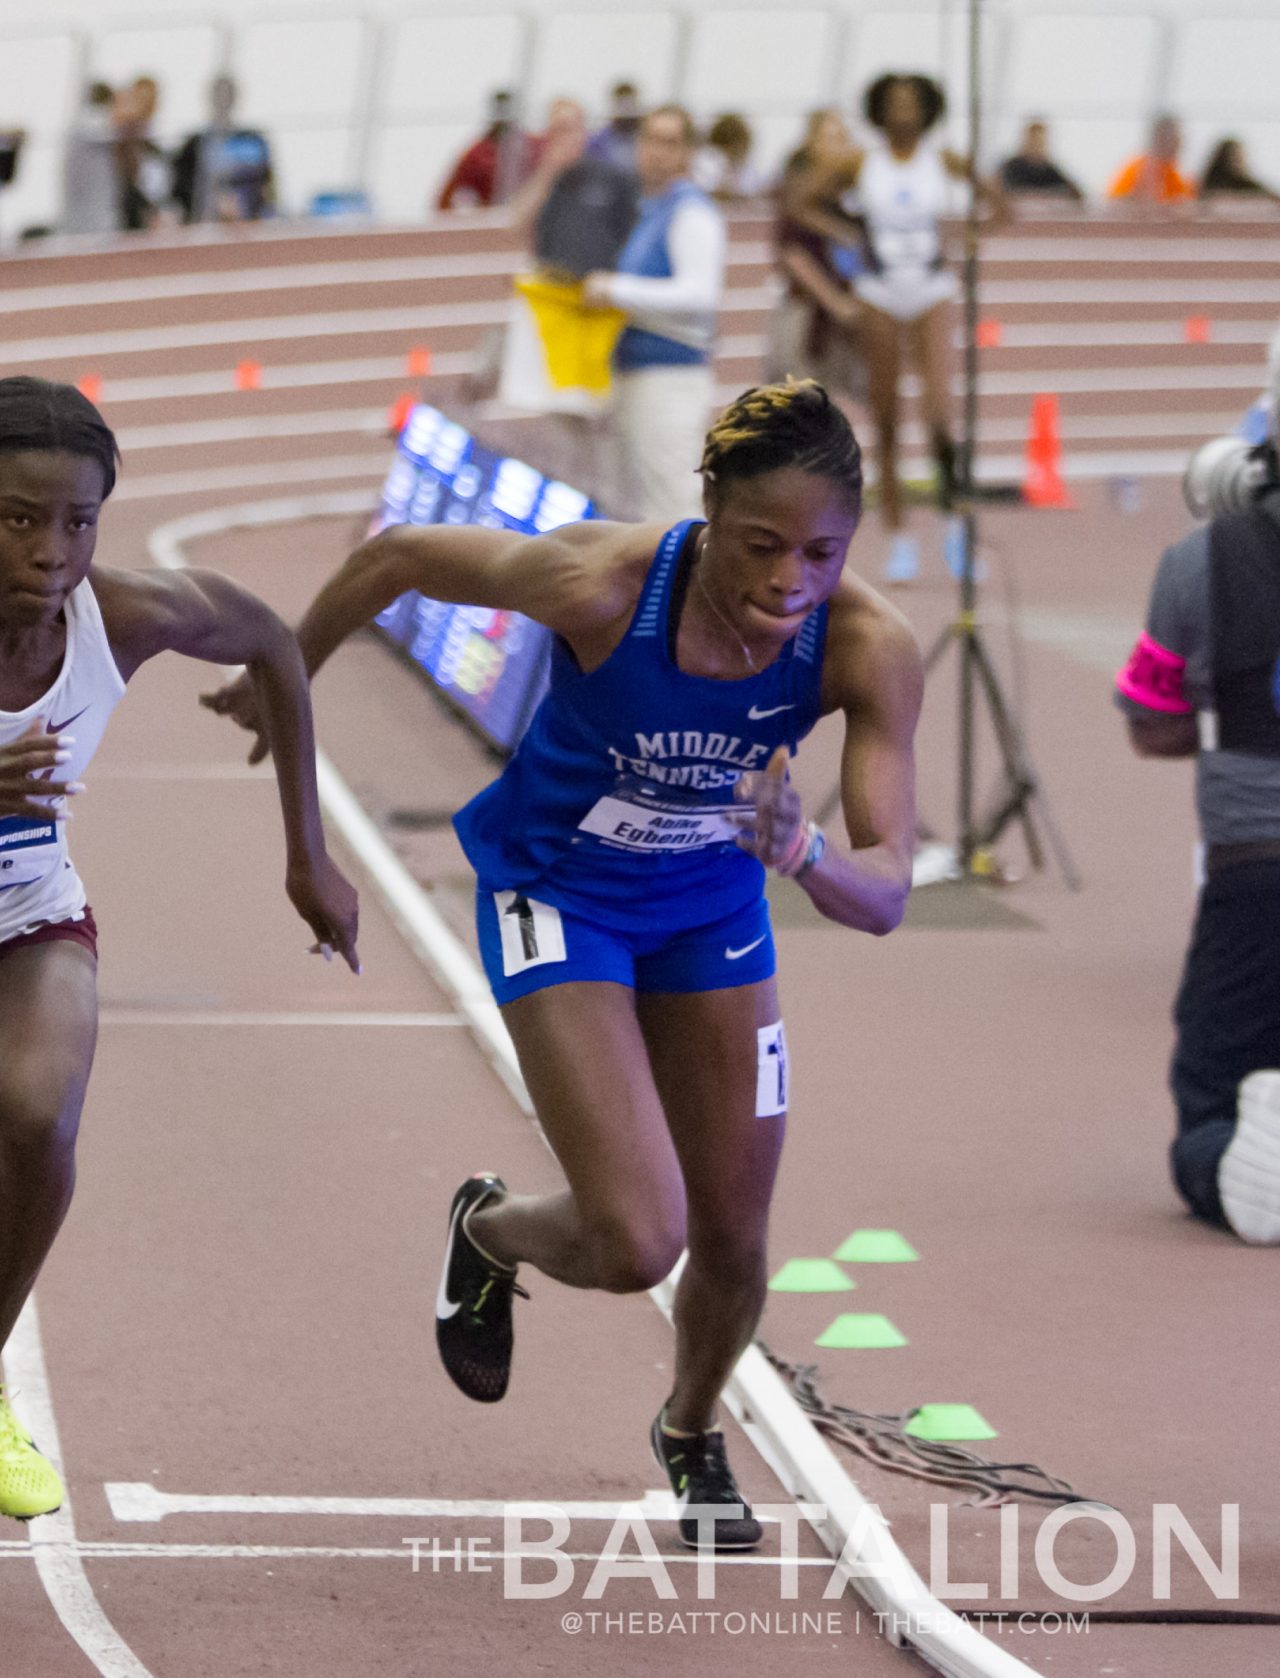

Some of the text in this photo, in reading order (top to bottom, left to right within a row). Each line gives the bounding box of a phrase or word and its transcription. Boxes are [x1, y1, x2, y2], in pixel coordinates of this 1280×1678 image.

[634, 730, 769, 769] MIDDLE
[647, 816, 703, 830] Abike
[504, 892, 540, 962] 1
[767, 1027, 787, 1107] 1
